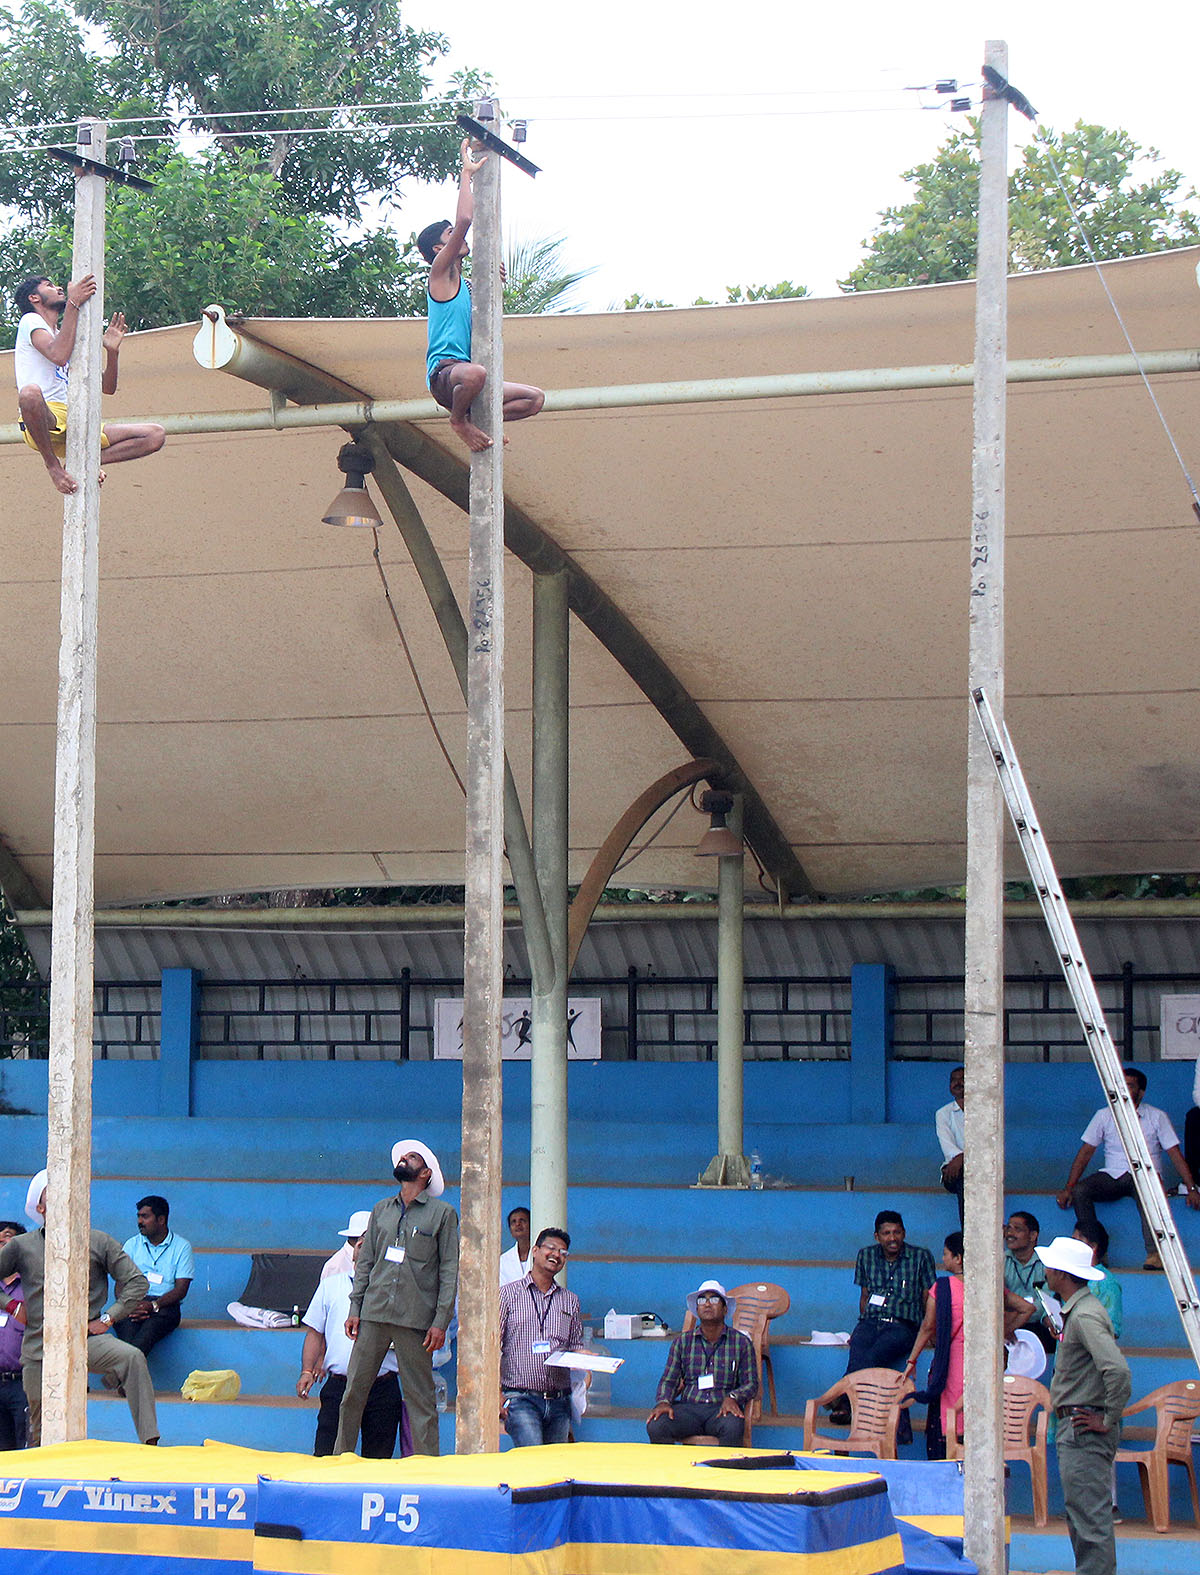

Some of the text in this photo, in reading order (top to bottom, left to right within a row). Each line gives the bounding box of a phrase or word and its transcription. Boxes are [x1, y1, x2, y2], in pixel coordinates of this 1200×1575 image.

[83, 1487, 247, 1521] Vinex H-2
[361, 1492, 420, 1533] P-5
